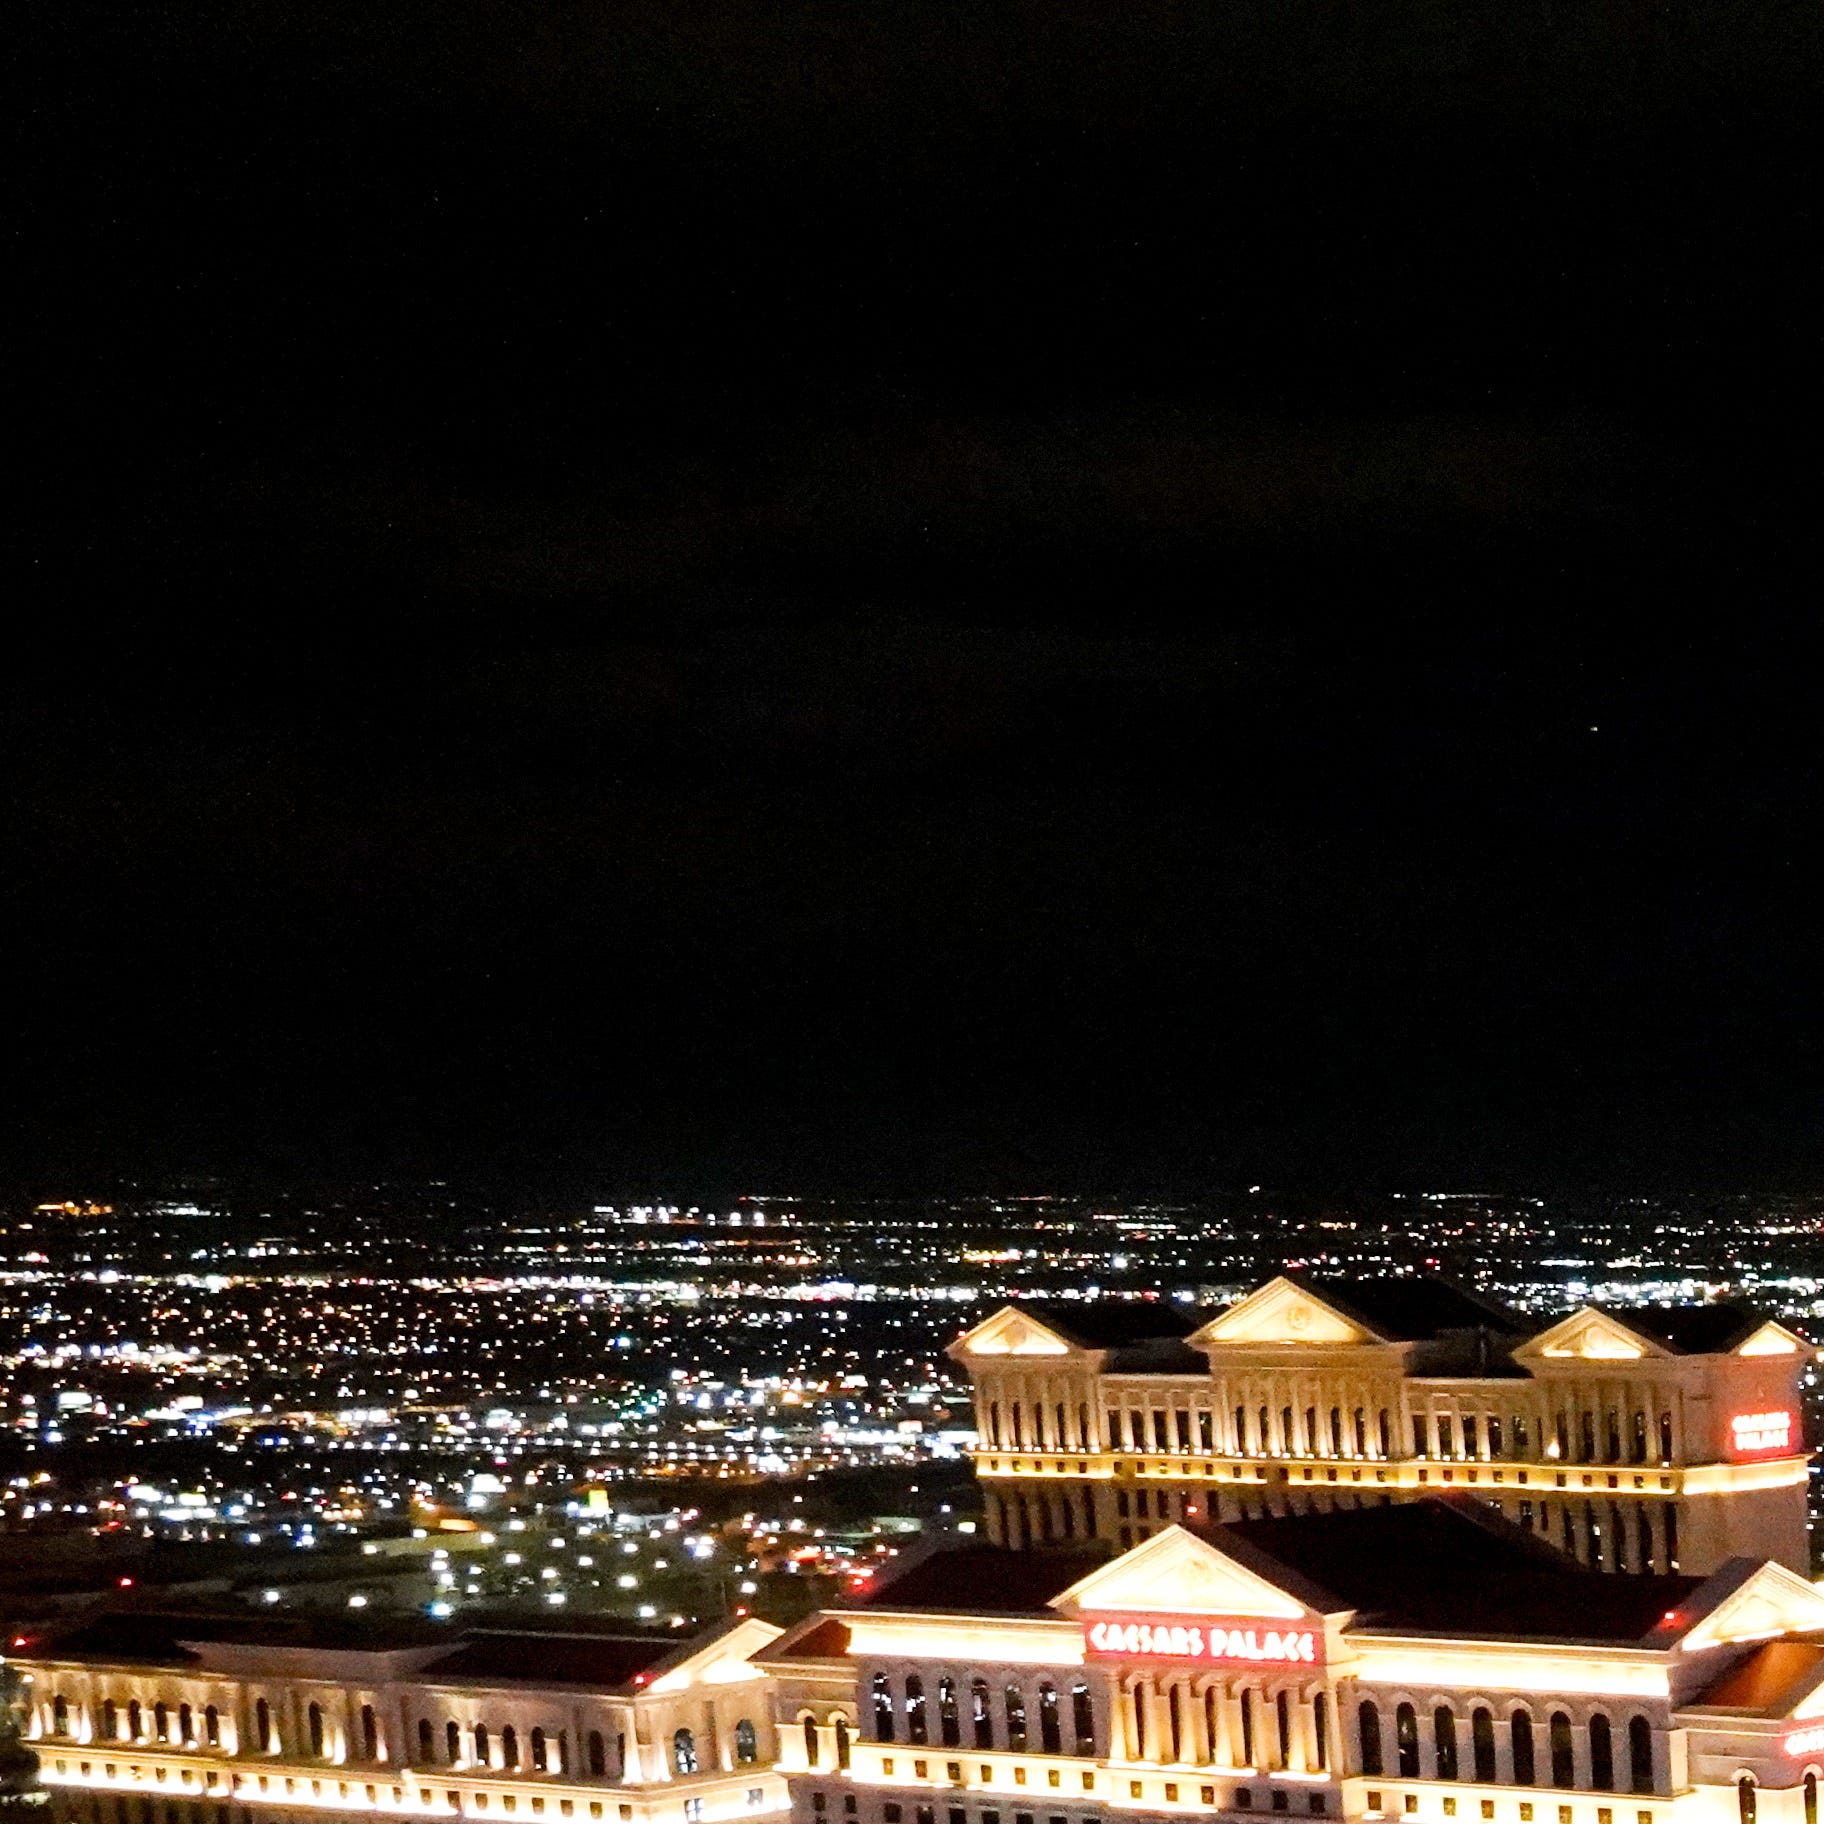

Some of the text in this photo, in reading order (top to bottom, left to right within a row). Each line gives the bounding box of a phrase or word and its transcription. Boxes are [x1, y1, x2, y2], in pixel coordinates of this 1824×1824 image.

[1731, 1411, 1791, 1432] CAESARS
[1089, 1621, 1315, 1662] CAESARS PALACE
